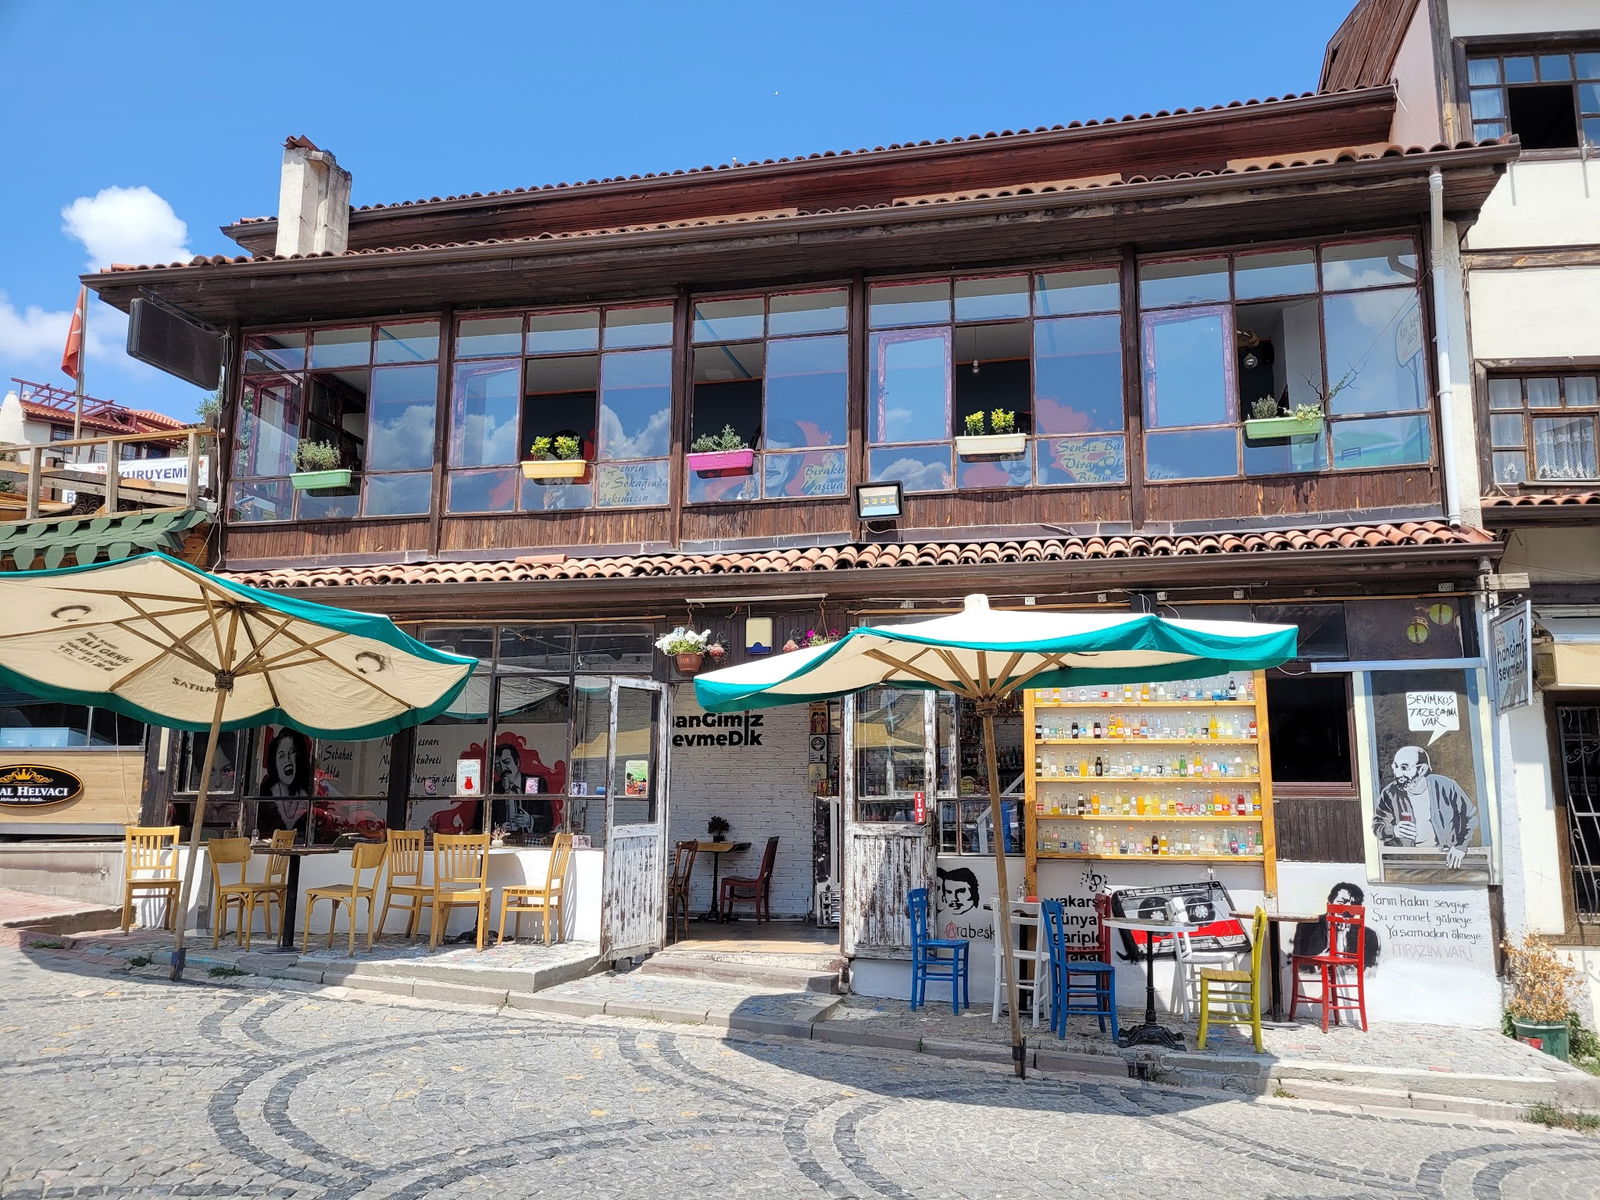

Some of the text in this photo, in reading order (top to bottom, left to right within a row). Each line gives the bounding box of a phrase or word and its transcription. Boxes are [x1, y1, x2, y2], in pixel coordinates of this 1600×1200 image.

[17, 786, 69, 797] HELVACI
[1399, 894, 1429, 908] kalan
[1434, 900, 1470, 915] sevgiye
[1393, 911, 1432, 923] emanet
[1435, 914, 1472, 929] gülmeye
[944, 920, 996, 941] Arabesk
[1451, 928, 1482, 945] ölmeye
